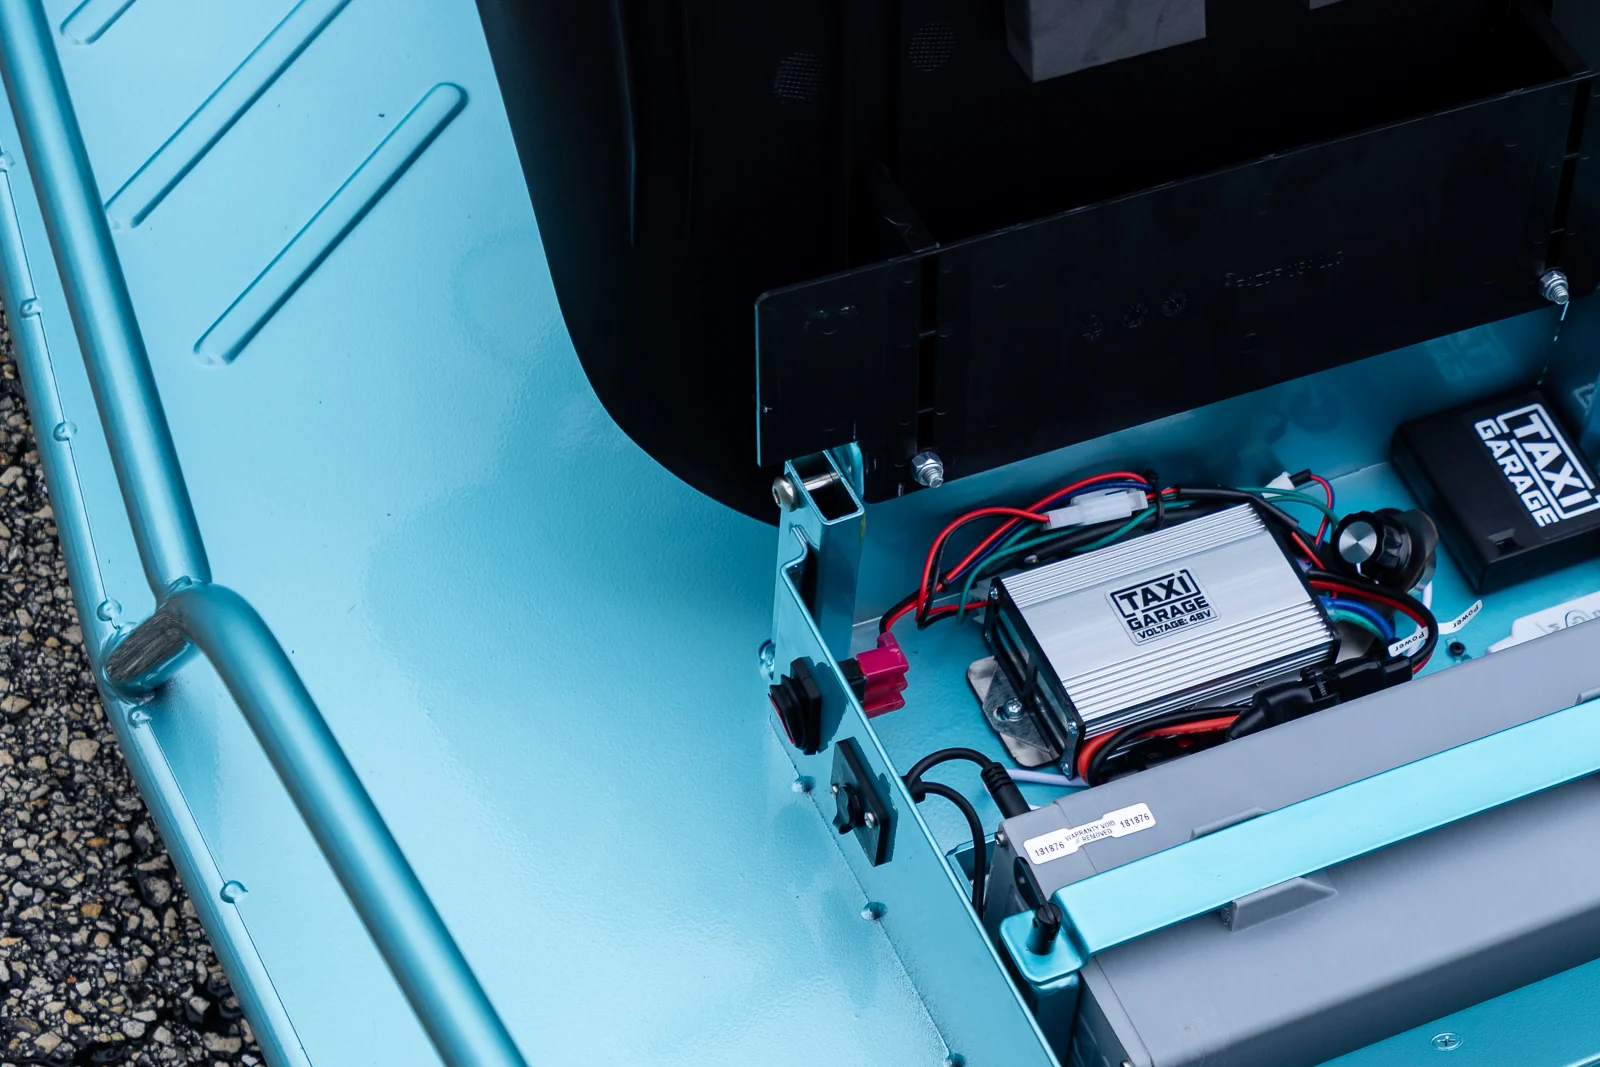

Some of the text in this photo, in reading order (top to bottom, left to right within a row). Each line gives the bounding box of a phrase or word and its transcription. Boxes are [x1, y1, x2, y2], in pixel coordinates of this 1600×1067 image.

[1474, 418, 1560, 527] GARAGE
[1512, 412, 1592, 508] TAXI
[1118, 575, 1192, 611] TAXI
[1126, 595, 1210, 631] GARAGE
[1137, 609, 1211, 639] VOLTAGE: 48V
[1452, 604, 1480, 629] Power
[1394, 630, 1425, 653] Power
[1065, 820, 1116, 842] WARRANTY VOID
[1120, 812, 1150, 828] 181876
[1082, 828, 1113, 842] REMOVED
[1034, 841, 1065, 857] 181876
